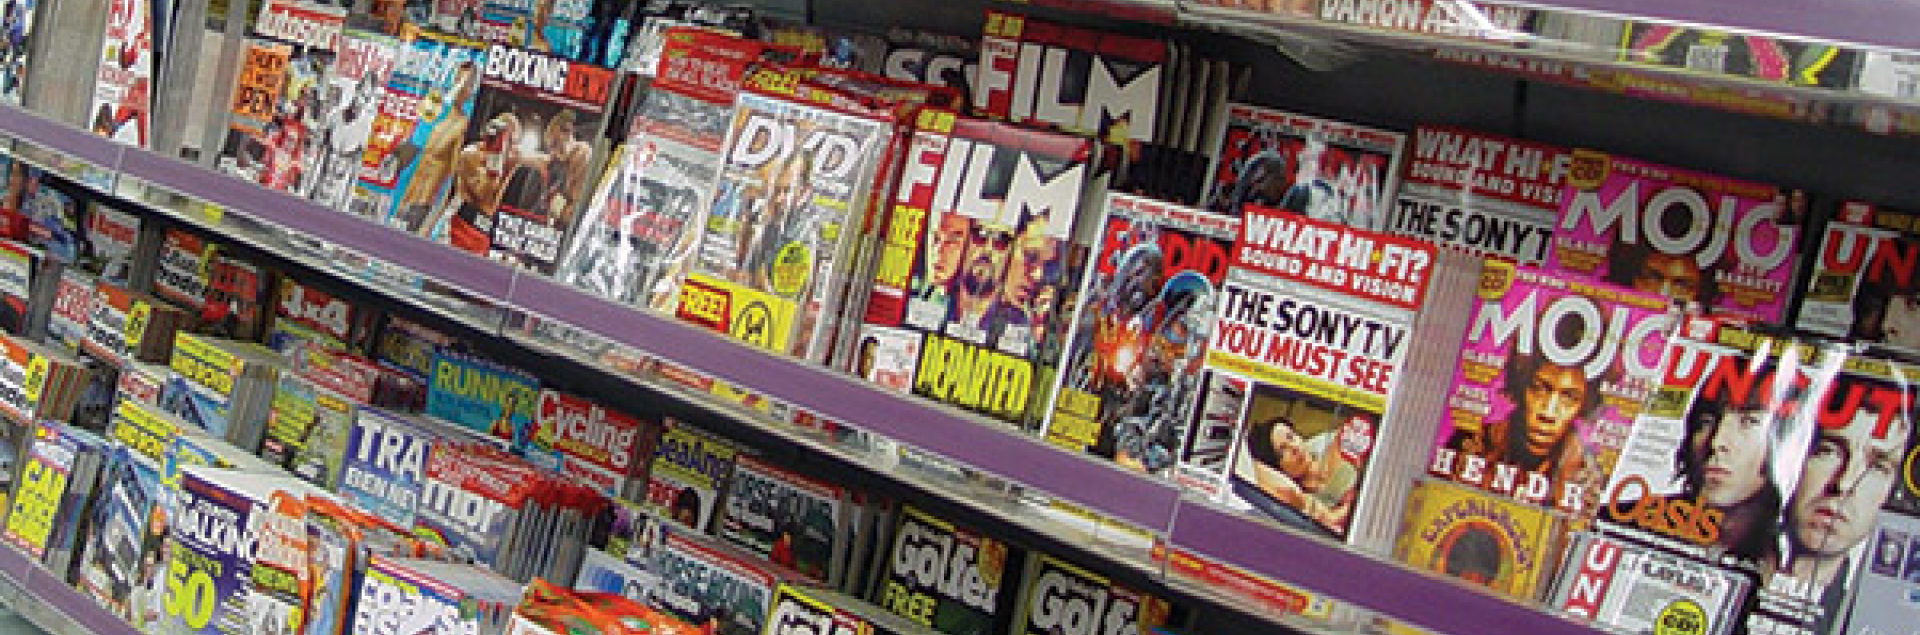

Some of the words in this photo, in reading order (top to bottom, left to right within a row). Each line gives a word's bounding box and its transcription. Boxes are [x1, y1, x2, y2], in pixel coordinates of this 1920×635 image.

[486, 43, 567, 93] BOXING
[973, 36, 1161, 142] FILM
[727, 113, 862, 181] DVD
[1416, 126, 1505, 166] WHAT
[897, 132, 1086, 240] FILM
[1245, 210, 1337, 261] WHAT
[1395, 199, 1440, 235] THE
[1440, 207, 1534, 250] SONY
[1561, 181, 1797, 274] MOJO
[1240, 246, 1302, 277] SOUND
[1304, 261, 1345, 286] AND
[1352, 271, 1415, 303] VISION
[1215, 318, 1265, 359] YOU
[1264, 332, 1347, 382] MUST
[1344, 353, 1394, 397] SEE
[1224, 285, 1272, 328] THE
[1272, 299, 1360, 350] SONY
[1360, 318, 1407, 361] TV
[1469, 288, 1670, 381] MOJO
[914, 331, 1035, 418] DEPARTED
[537, 388, 637, 467] Cycling
[1609, 474, 1724, 544] Oasis
[163, 556, 216, 630] 50
[883, 579, 936, 626] FREE
